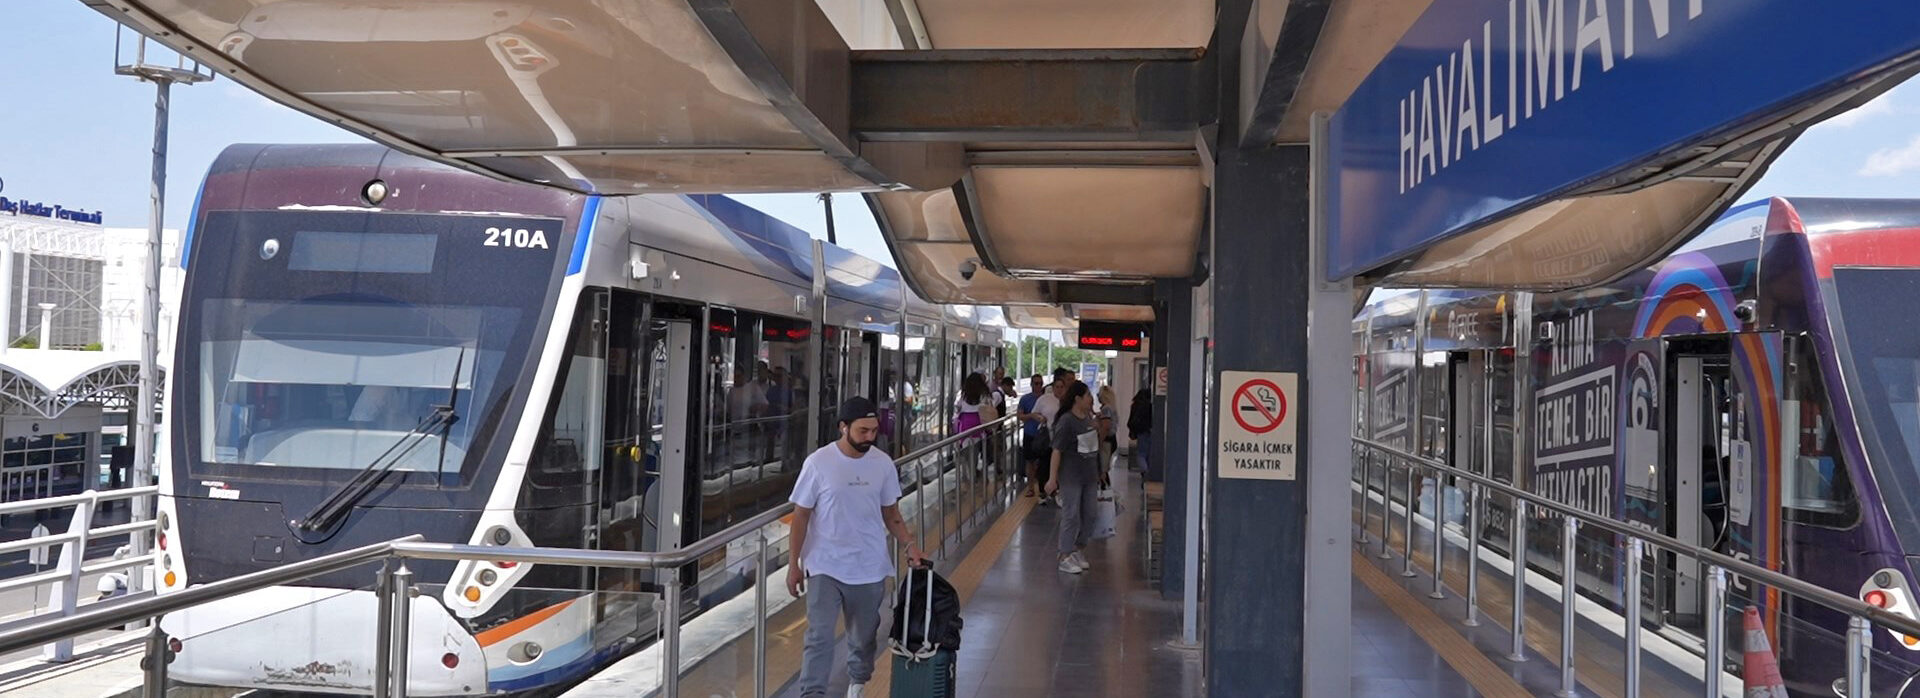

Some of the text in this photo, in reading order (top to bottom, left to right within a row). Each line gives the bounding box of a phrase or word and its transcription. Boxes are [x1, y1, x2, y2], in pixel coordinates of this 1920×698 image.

[20, 199, 53, 218] Hatlar
[54, 204, 102, 225] Terminali
[484, 227, 549, 250] 210A
[1552, 310, 1595, 376] KLİMA
[1538, 393, 1579, 451] TEMEL
[1585, 379, 1611, 441] BİR
[1223, 439, 1293, 456] SİGARA İÇMEK
[1234, 458, 1281, 470] YASAKTIR
